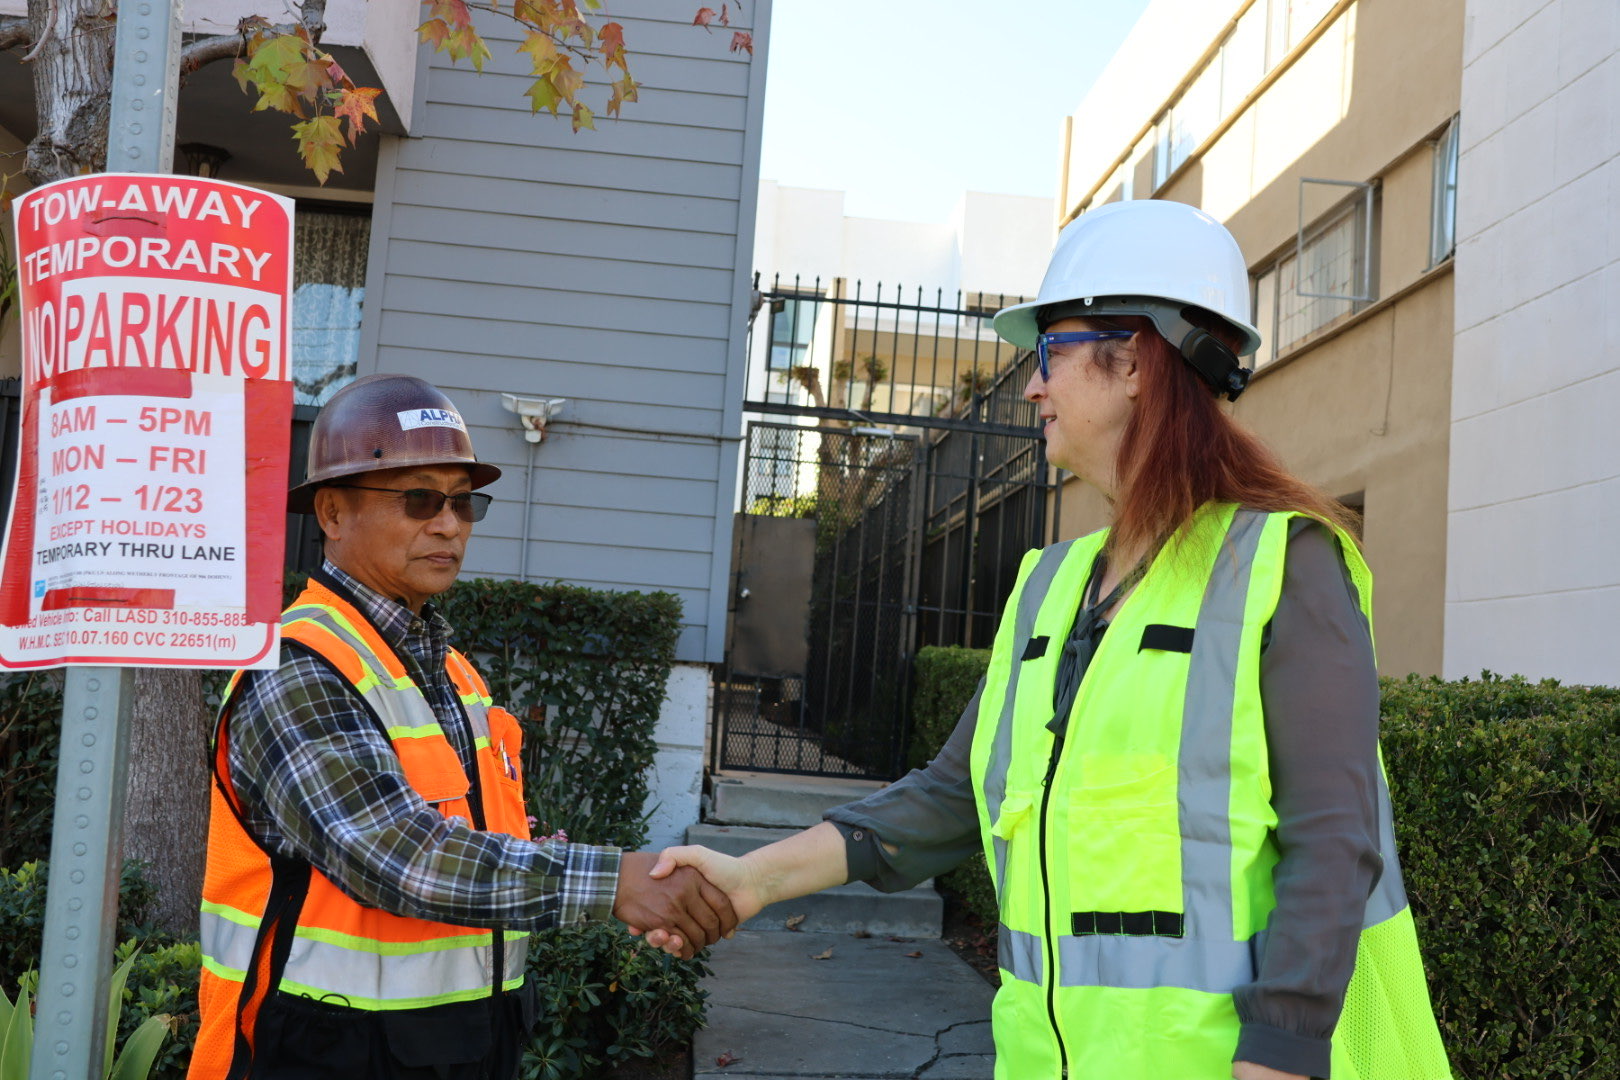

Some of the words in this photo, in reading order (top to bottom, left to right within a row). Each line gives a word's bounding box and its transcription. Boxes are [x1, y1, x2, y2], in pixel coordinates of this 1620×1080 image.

[29, 184, 263, 231] TOW-AWAY
[25, 236, 272, 286] TEMPORARY
[29, 301, 56, 385] NO
[63, 292, 271, 379] PARKING
[51, 405, 96, 438] 8AM
[138, 406, 212, 437] 5PM
[52, 444, 105, 477] MON
[149, 445, 206, 475] FRI
[52, 484, 91, 515] 1/12
[134, 485, 203, 514] 1/23
[50, 519, 95, 541] EXCEPT
[101, 520, 206, 539] HOLIDAYS
[37, 541, 112, 565] TEMPORARY
[118, 542, 174, 560] THRU
[182, 545, 236, 562] LANE
[83, 608, 111, 622] Call
[116, 609, 158, 624] LASD
[162, 610, 255, 627] 310-855-885
[65, 630, 128, 645] 10.07.160
[133, 631, 165, 646] CVC
[170, 632, 236, 651] 22651(m)
